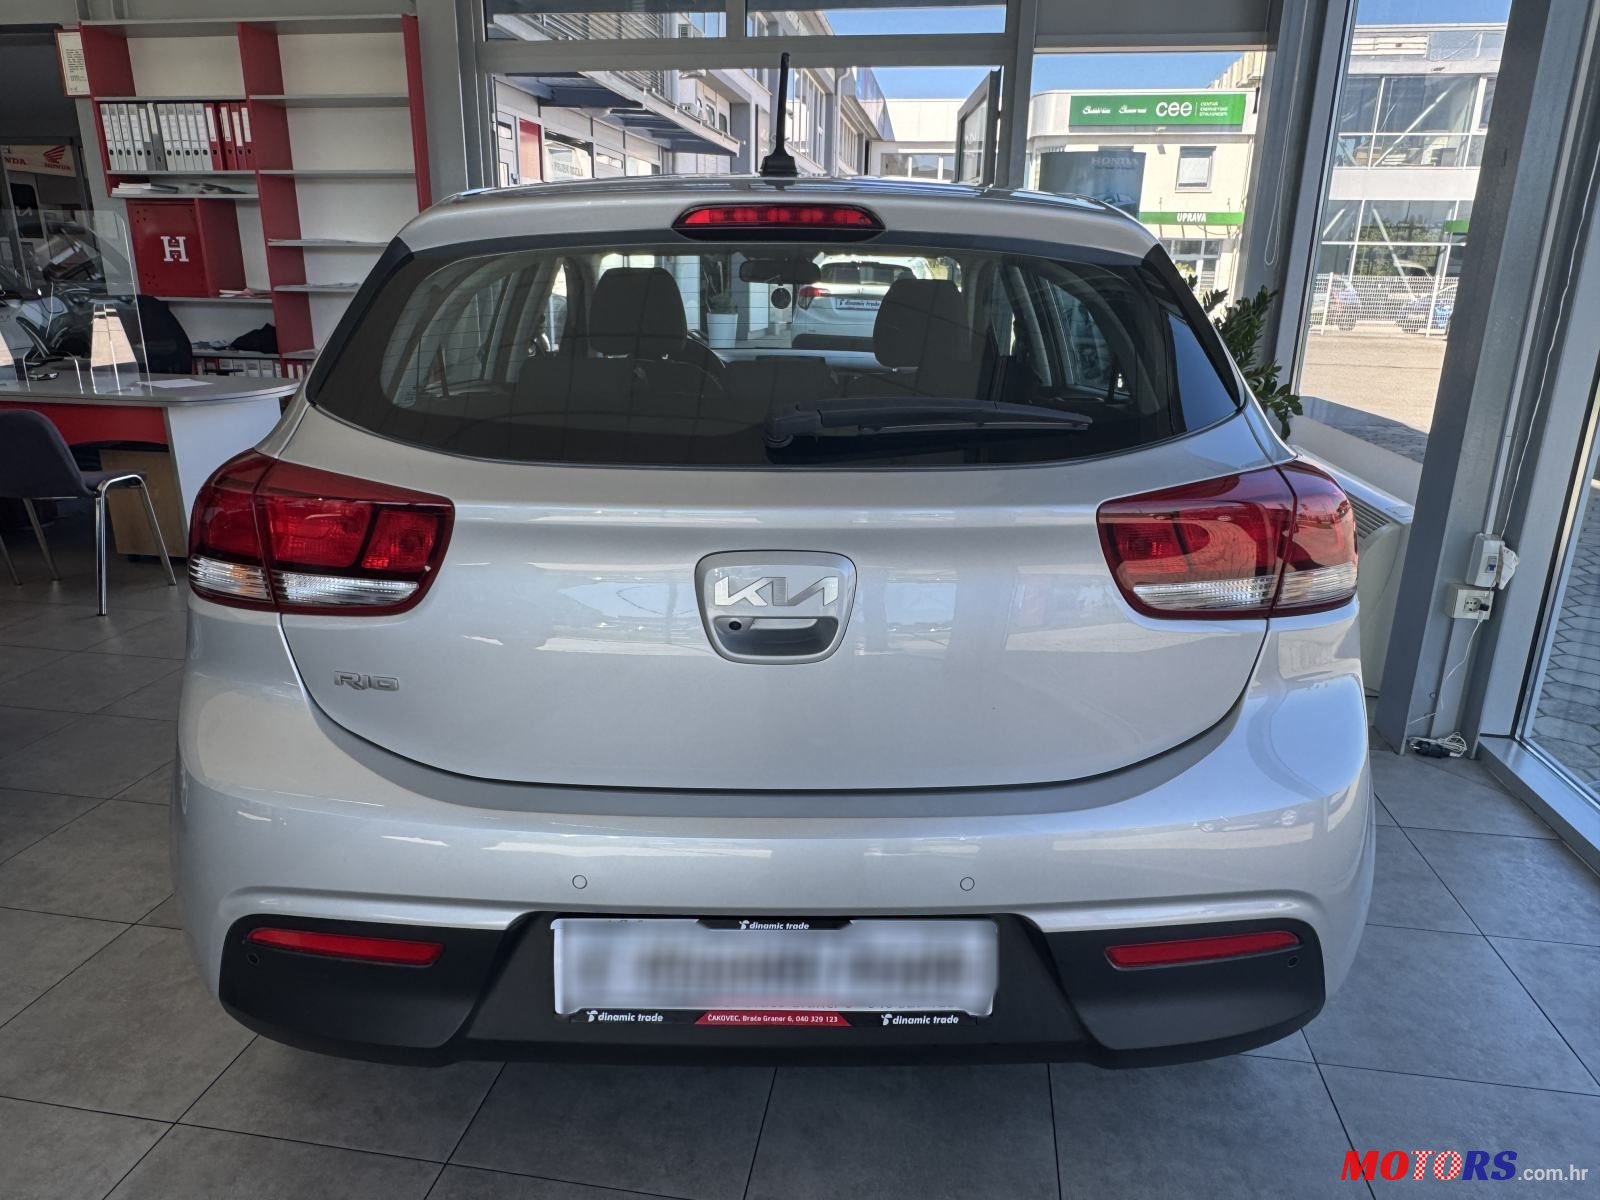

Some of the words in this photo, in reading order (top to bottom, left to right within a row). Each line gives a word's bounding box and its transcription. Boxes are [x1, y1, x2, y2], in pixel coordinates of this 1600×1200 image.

[1156, 101, 1192, 117] cee
[1176, 211, 1207, 223] UPRAVA
[160, 236, 190, 262] H
[714, 576, 839, 606] KIA
[334, 670, 400, 692] RIO
[749, 921, 785, 930] dinamic
[786, 922, 810, 930] trade
[598, 1011, 635, 1021] dinamic
[637, 1013, 664, 1022] trade
[707, 1013, 740, 1022] ČAKOVEC,
[892, 1015, 931, 1025] dinamic
[933, 1015, 960, 1024] trade
